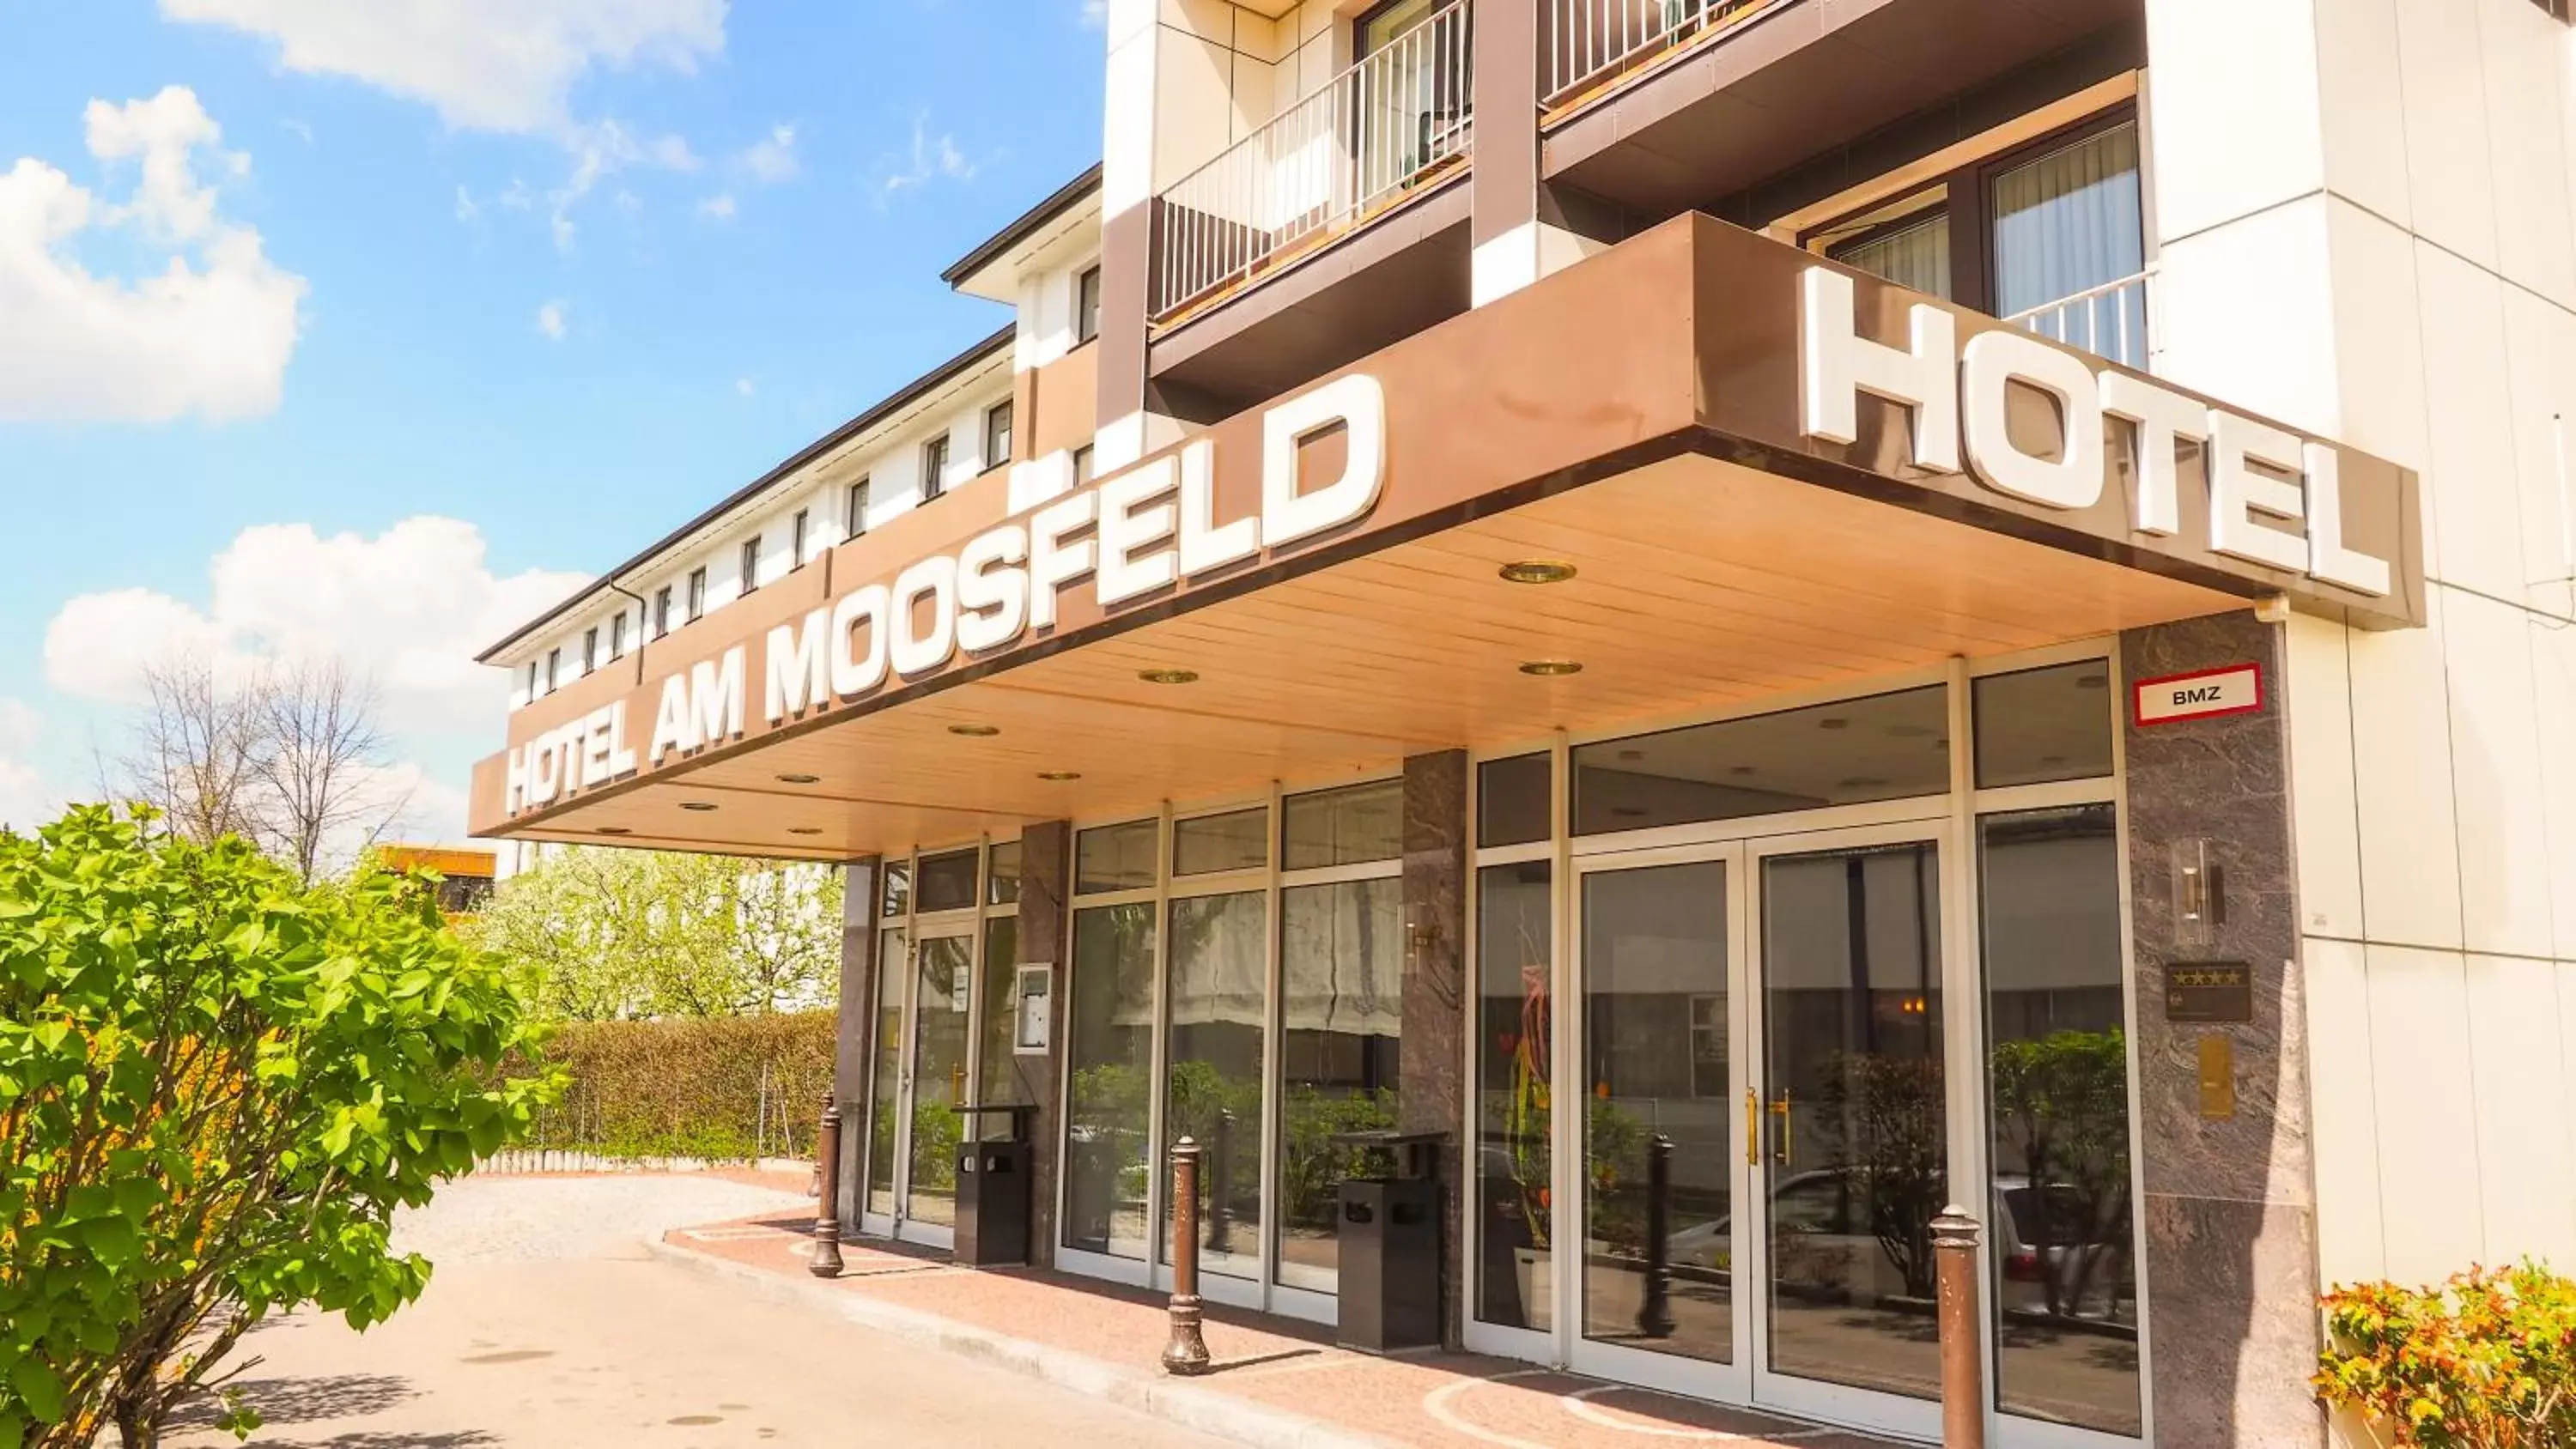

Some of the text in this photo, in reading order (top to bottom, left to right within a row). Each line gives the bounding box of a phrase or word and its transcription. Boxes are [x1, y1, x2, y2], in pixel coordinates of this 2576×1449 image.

[505, 373, 1386, 815] HOTEL AM MOOSFELD
[1801, 265, 2390, 597] HOTEL
[2172, 686, 2221, 706] BMZ
